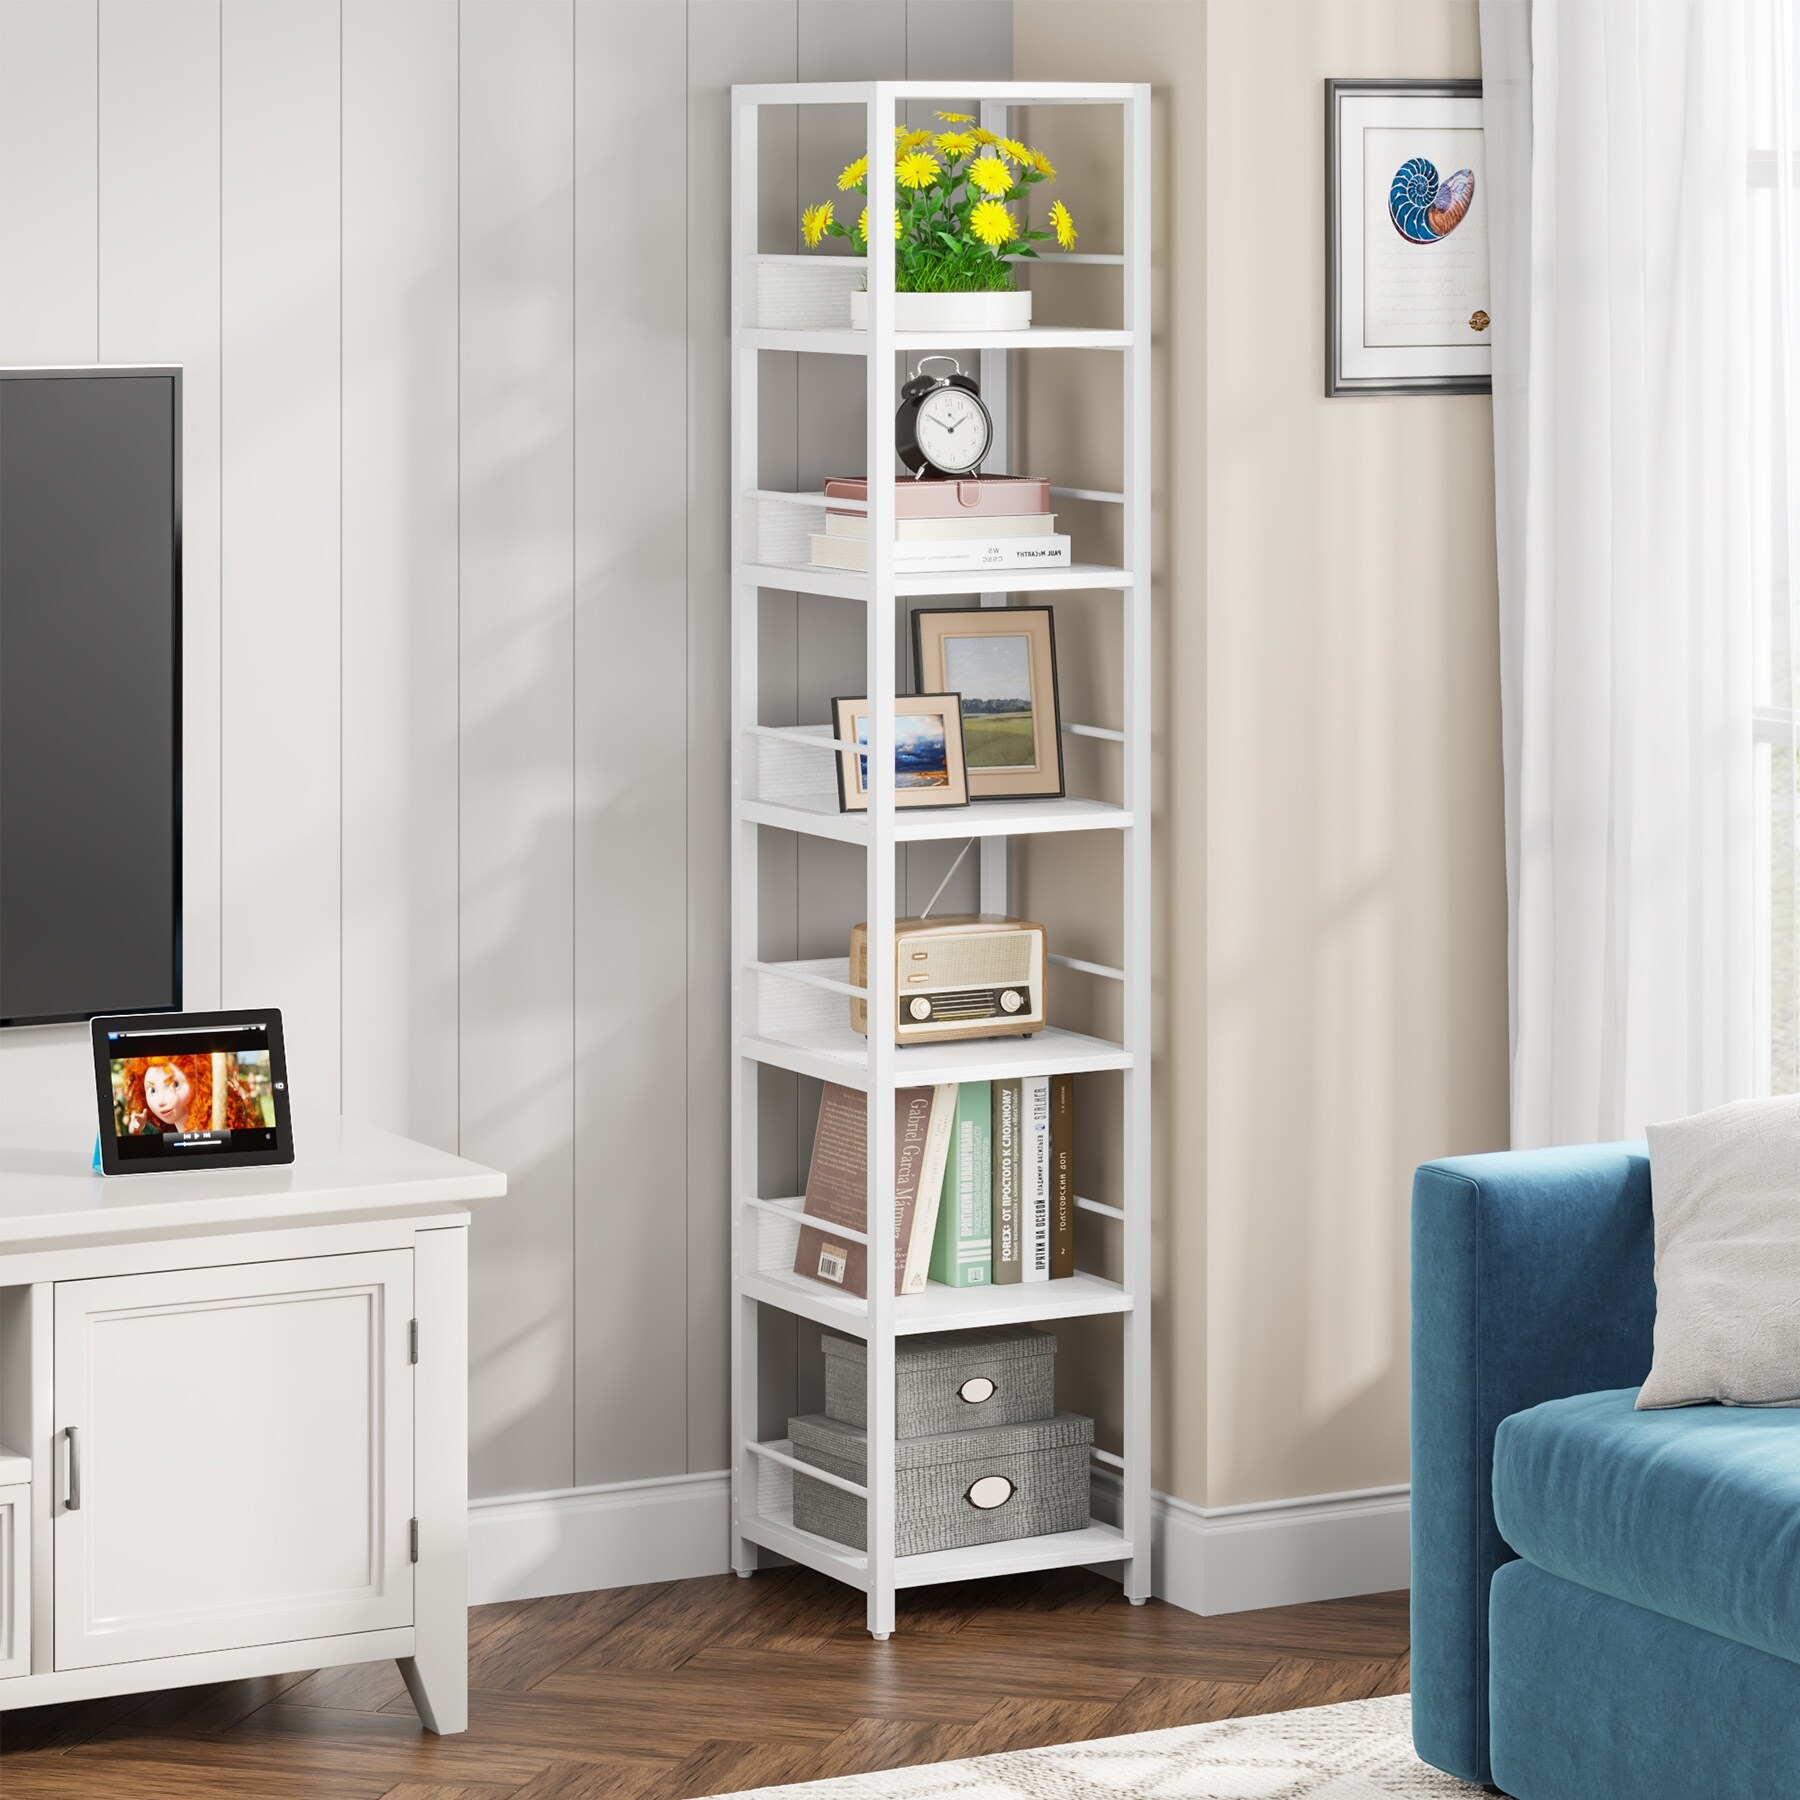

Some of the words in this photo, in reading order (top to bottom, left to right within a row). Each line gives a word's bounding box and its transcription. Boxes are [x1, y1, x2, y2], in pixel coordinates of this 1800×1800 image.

[904, 1098, 928, 1142] Gabriel
[1002, 1089, 1012, 1147] СЛОЖНОМУ
[898, 1145, 920, 1184] García
[1002, 1148, 1012, 1156] К
[1059, 1152, 1067, 1170] ДОМ
[1002, 1158, 1012, 1207] ПРОСТОГО
[1002, 1209, 1012, 1222] ОТ
[1033, 1199, 1045, 1227] ОСЕВОЙ
[1059, 1173, 1067, 1231] ТОЛСТОВСКИЙ
[1002, 1224, 1012, 1262] FOREX:
[1035, 1229, 1045, 1240] НА
[1035, 1241, 1045, 1270] ПРЯТКИ
